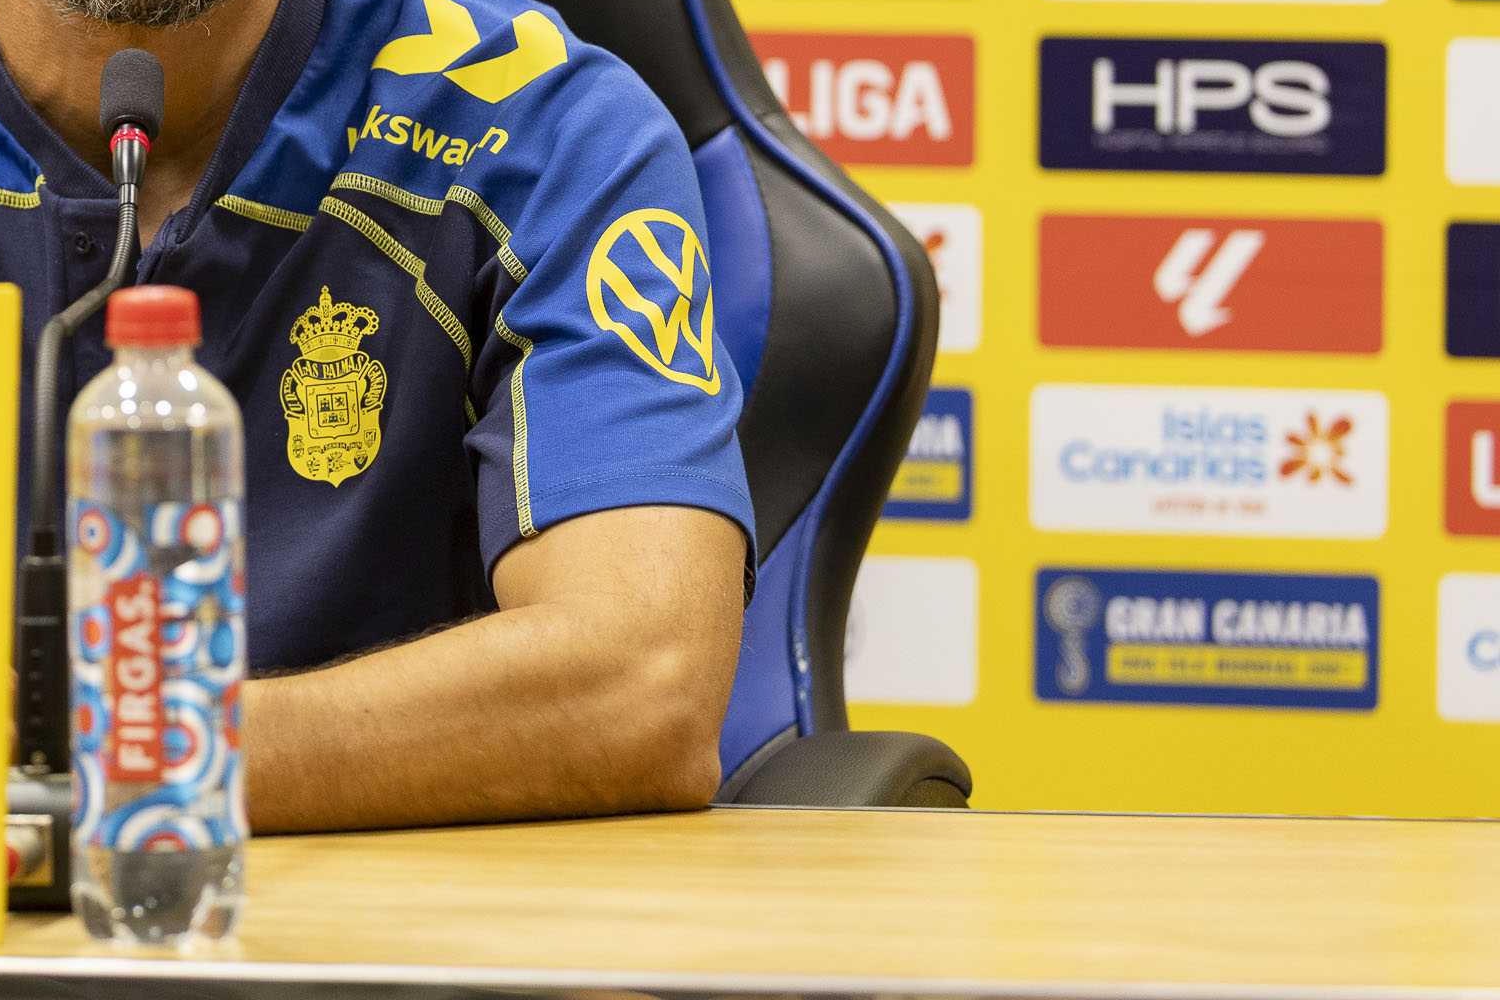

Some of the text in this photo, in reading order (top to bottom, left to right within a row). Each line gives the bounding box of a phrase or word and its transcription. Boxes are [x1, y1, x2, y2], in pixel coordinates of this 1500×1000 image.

[1092, 56, 1332, 137] HPS
[296, 354, 364, 379] LAS PALMAS
[1105, 597, 1369, 647] GRAN CANARIA
